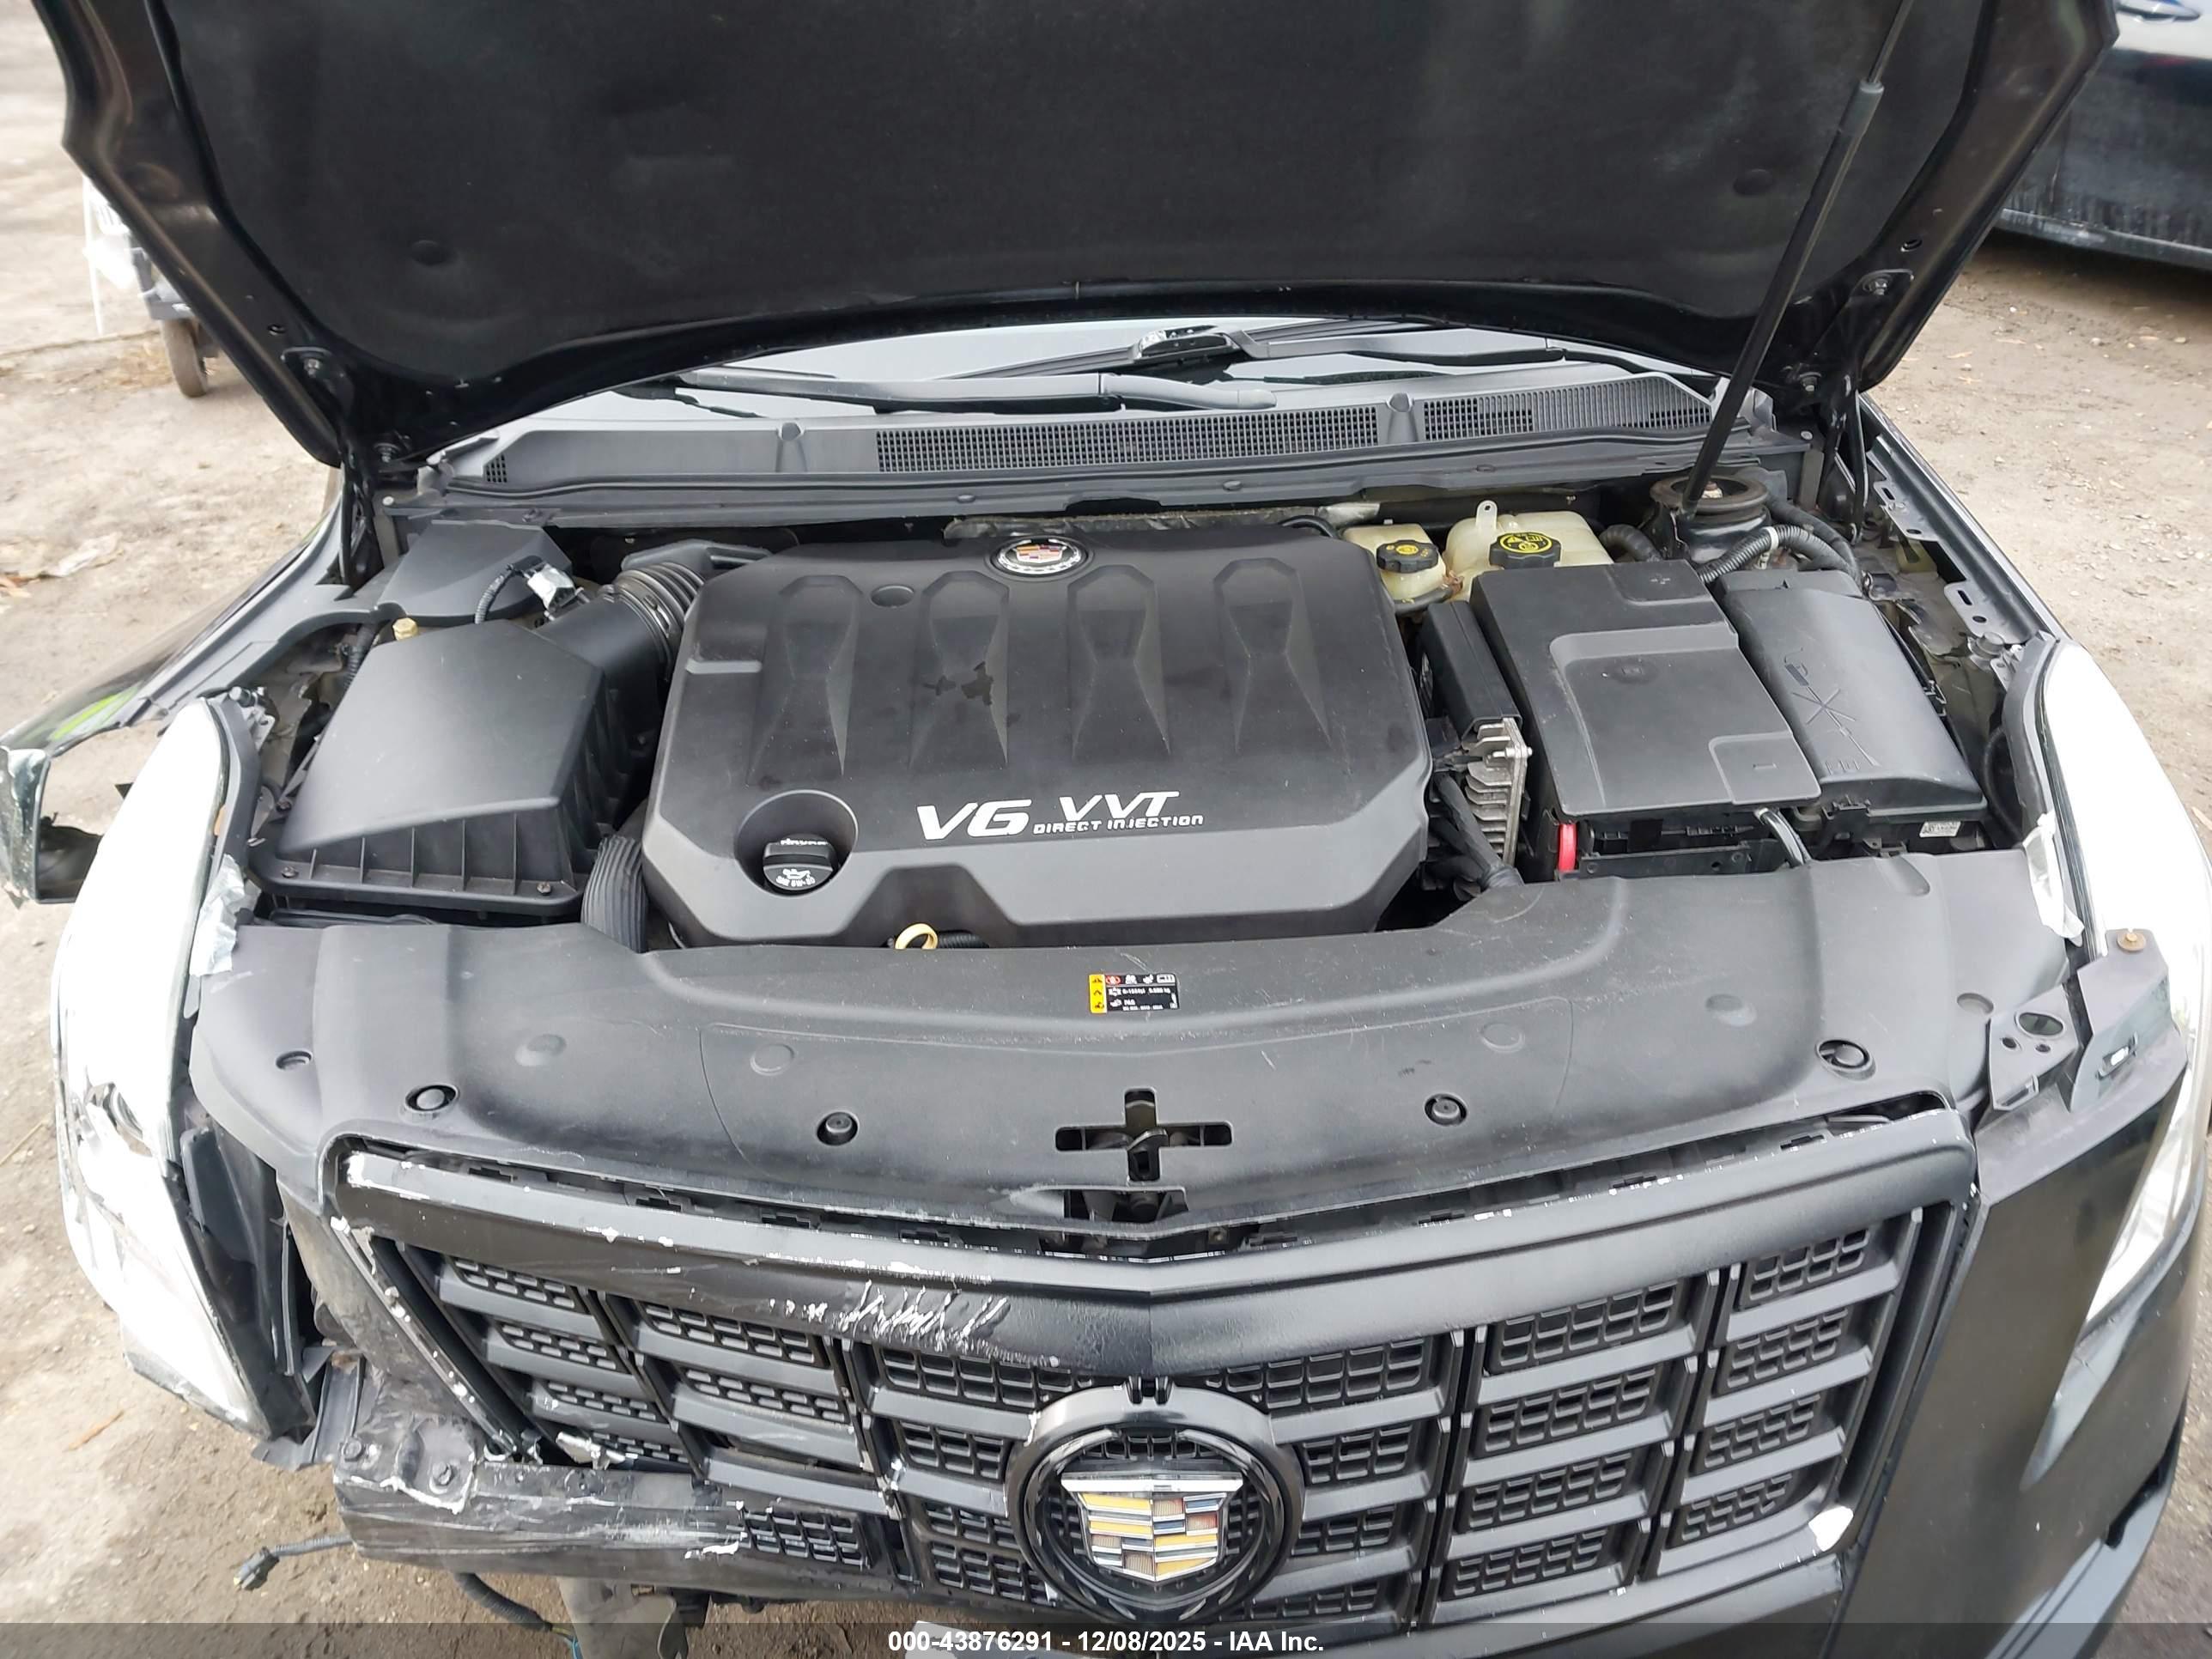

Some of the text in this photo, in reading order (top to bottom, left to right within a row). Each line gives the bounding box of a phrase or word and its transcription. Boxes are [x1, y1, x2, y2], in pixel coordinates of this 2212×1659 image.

[916, 791, 1180, 841] V6 VVT
[1033, 815, 1204, 836] DIRECT INJECTION
